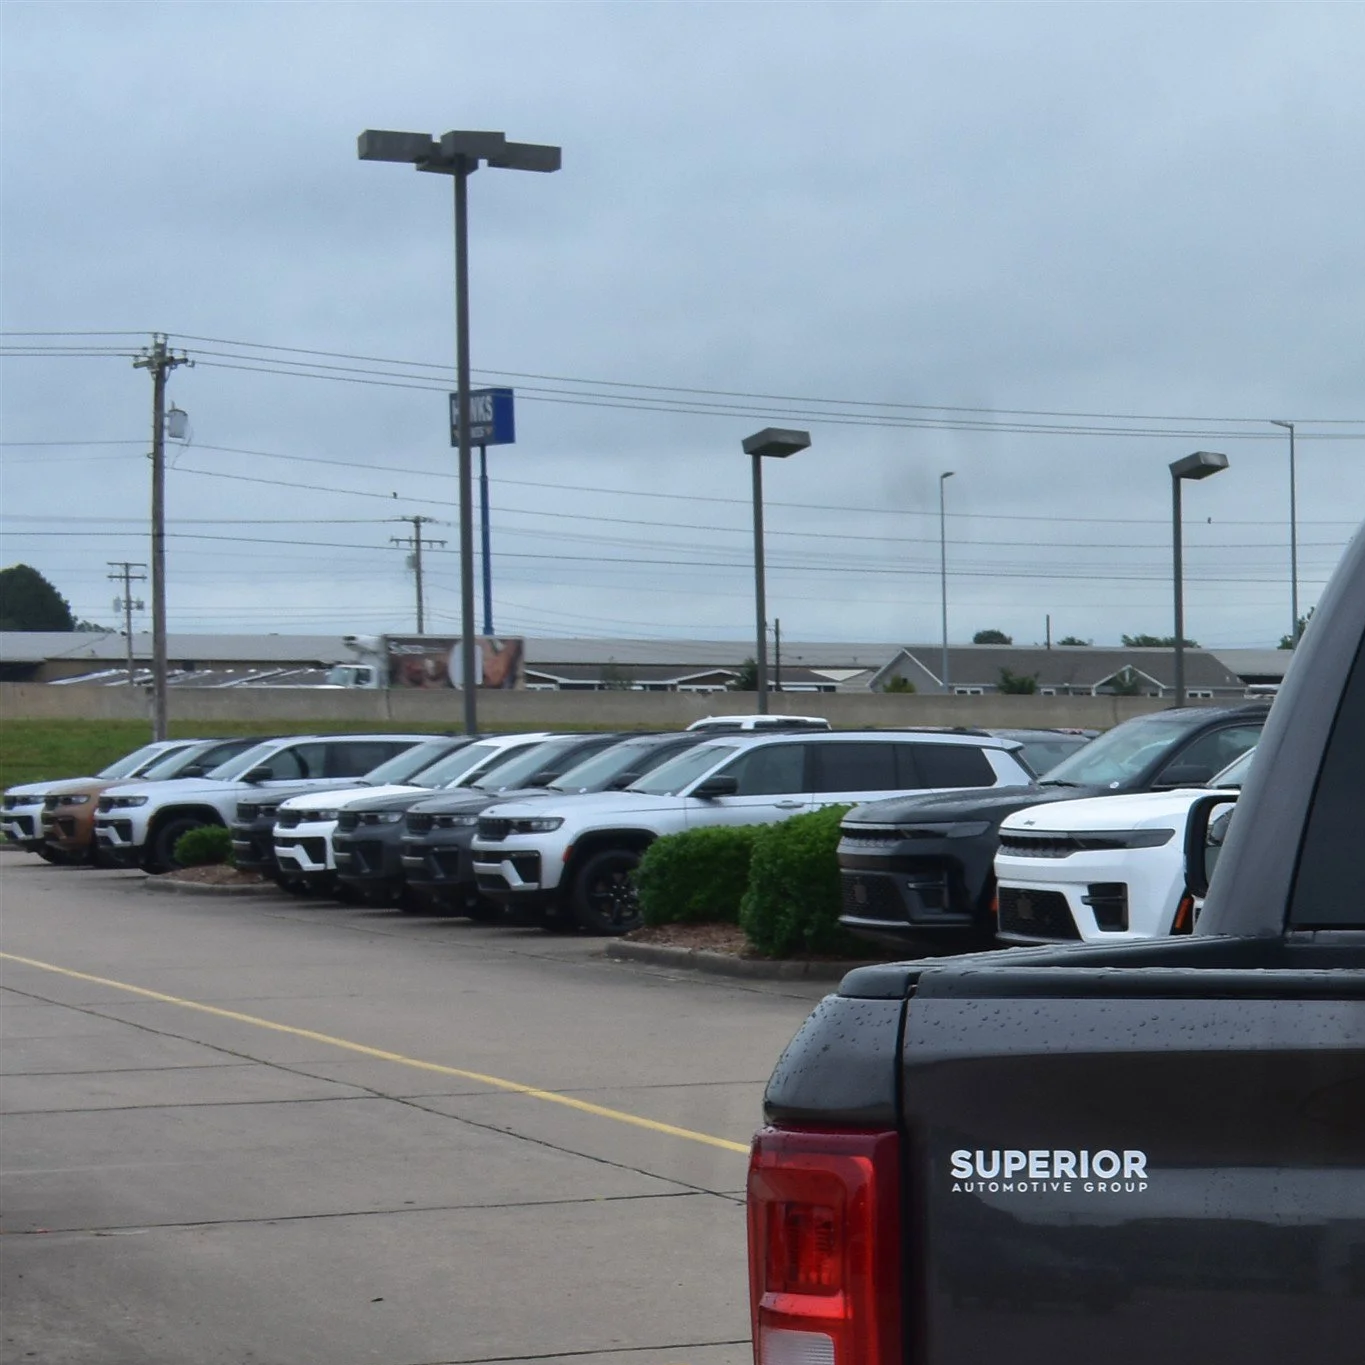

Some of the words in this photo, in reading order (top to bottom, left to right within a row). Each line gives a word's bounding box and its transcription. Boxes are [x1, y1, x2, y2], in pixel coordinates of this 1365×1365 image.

[950, 1149, 1149, 1180] SUPERIOR
[951, 1182, 1073, 1193] AUTOMOTIVE
[1083, 1182, 1149, 1193] GROUP
